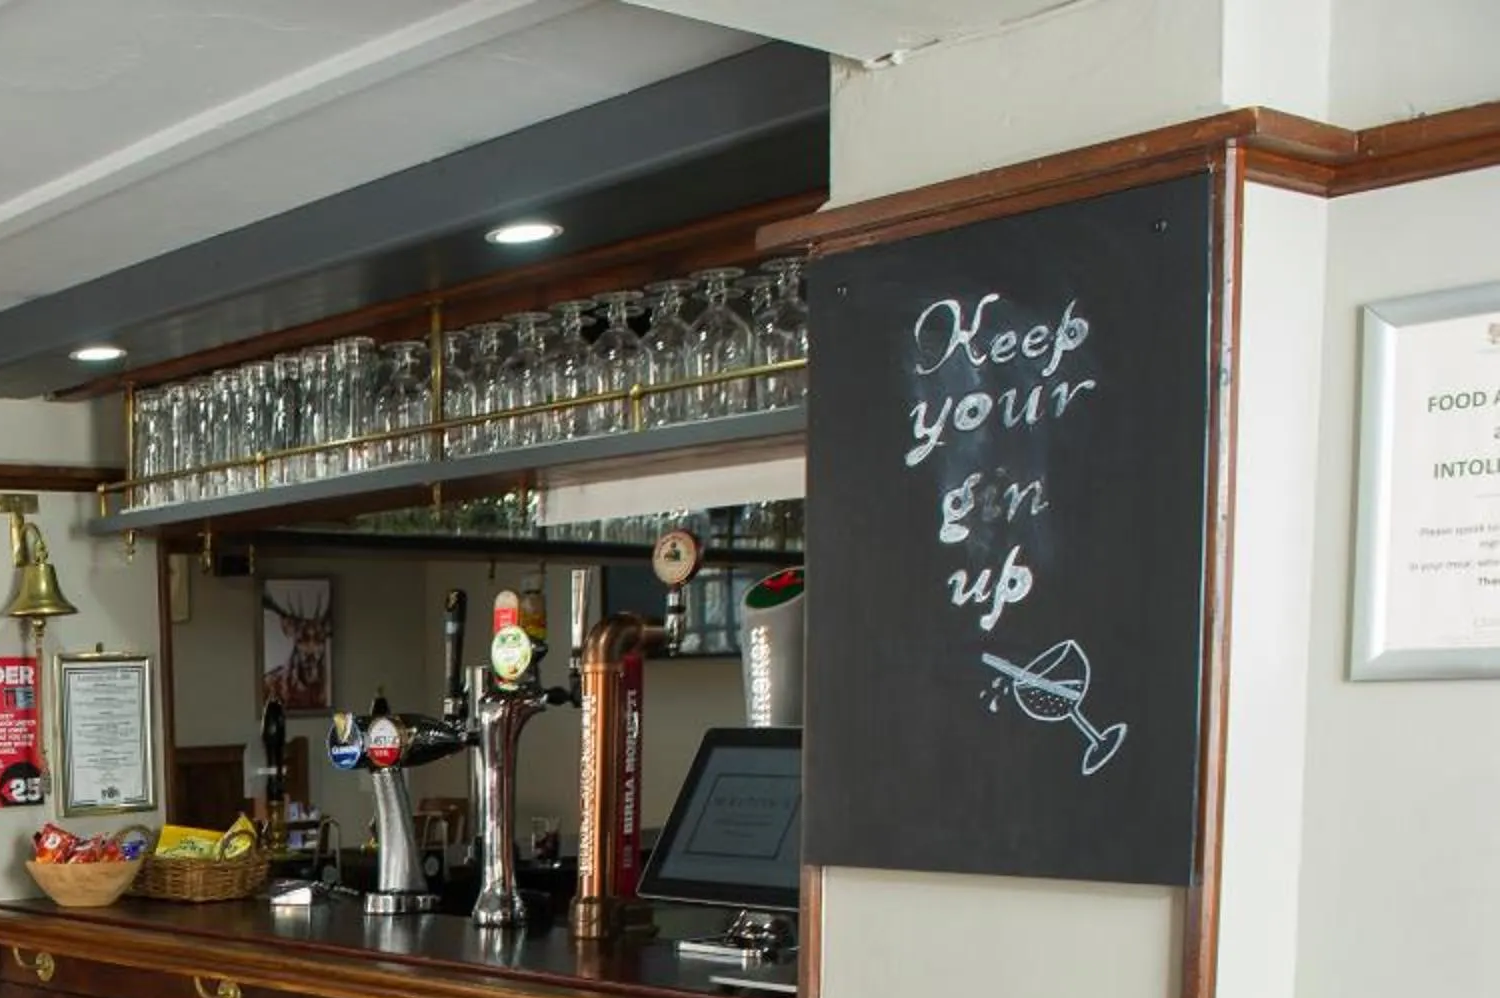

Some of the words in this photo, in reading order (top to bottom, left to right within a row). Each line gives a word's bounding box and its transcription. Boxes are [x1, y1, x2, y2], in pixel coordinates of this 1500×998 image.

[914, 293, 1090, 375] Keep
[905, 379, 1096, 467] your
[1427, 391, 1487, 413] FOOD
[947, 545, 1034, 632] up
[10, 777, 41, 801] 25
